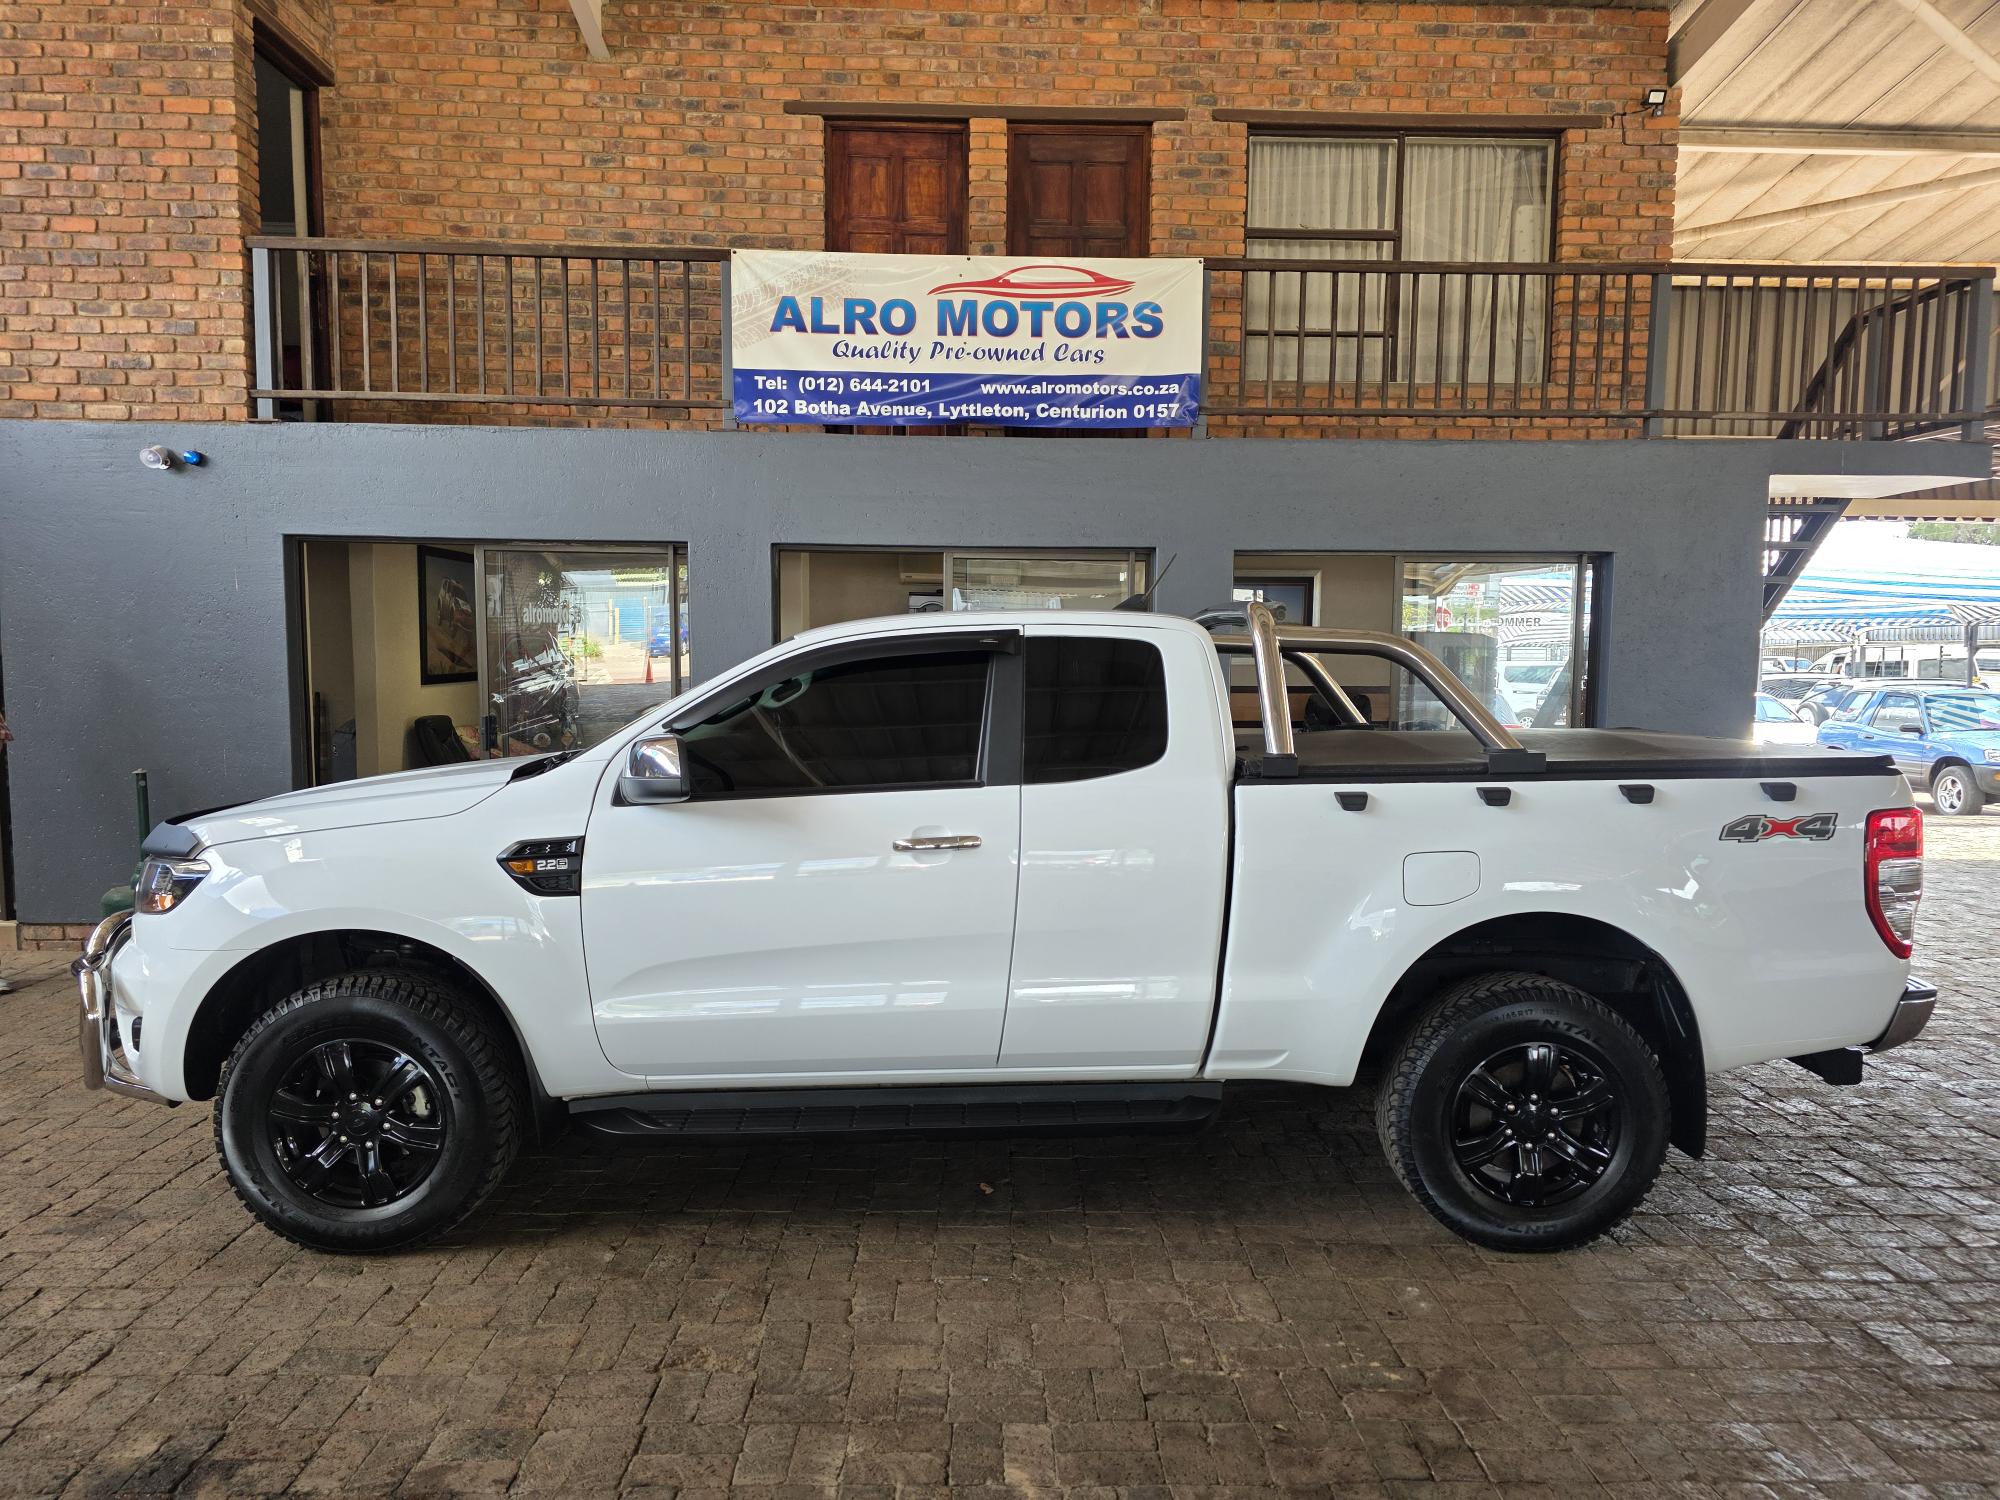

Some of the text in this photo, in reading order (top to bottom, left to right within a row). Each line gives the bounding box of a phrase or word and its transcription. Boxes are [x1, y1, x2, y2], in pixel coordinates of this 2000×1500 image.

[770, 296, 1164, 339] ALRO MOTORS
[832, 339, 1105, 364] Quality Pre-owned Cars
[754, 375, 930, 394] Tel: (012) 644-2101
[981, 382, 1180, 396] www.alromotors.co.za
[753, 399, 1180, 420] 102 Botha Avenue, Lyttleton, Centurion 0157
